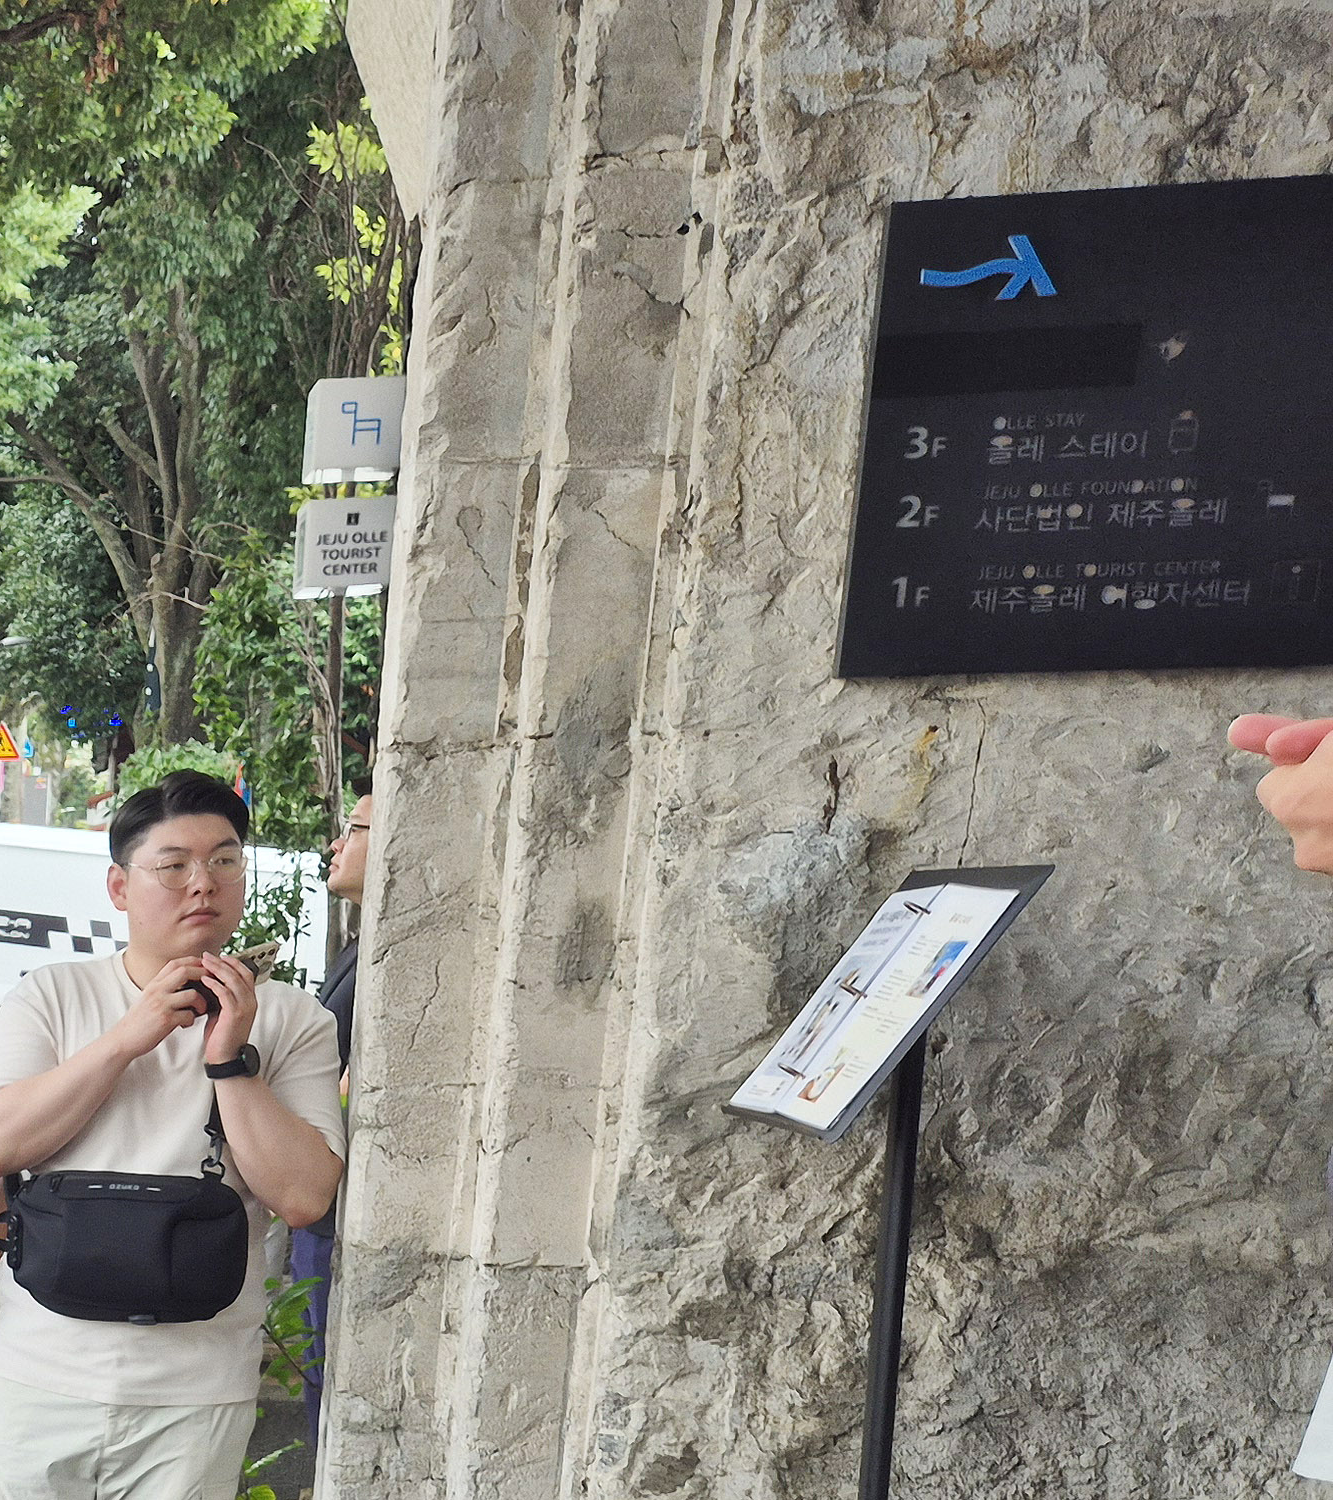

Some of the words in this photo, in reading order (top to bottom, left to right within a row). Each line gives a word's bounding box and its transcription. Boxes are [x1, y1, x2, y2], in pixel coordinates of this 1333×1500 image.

[993, 414, 1035, 431] OLLE
[1045, 413, 1085, 428] STAY
[903, 426, 948, 460] 3F
[986, 434, 1045, 465] 올레
[1053, 429, 1149, 459] 스테이
[984, 482, 1021, 500] JEJU
[1029, 481, 1074, 498] OLLE
[895, 495, 940, 528] 2F
[974, 503, 1093, 533] 사단법인
[1107, 498, 1228, 529] 제주올레
[316, 531, 348, 546] JEJU
[351, 530, 388, 544] OLLE
[320, 546, 382, 561] TOURIST
[322, 562, 378, 576] CENTER
[979, 564, 1015, 581] JEJU
[1022, 563, 1066, 579] OLLE
[1076, 561, 1147, 578] TOURIST
[1154, 559, 1221, 577] CENTER
[891, 576, 931, 609] 1F
[969, 583, 1087, 614] 제주올레
[1100, 579, 1251, 610] 여행자센터
